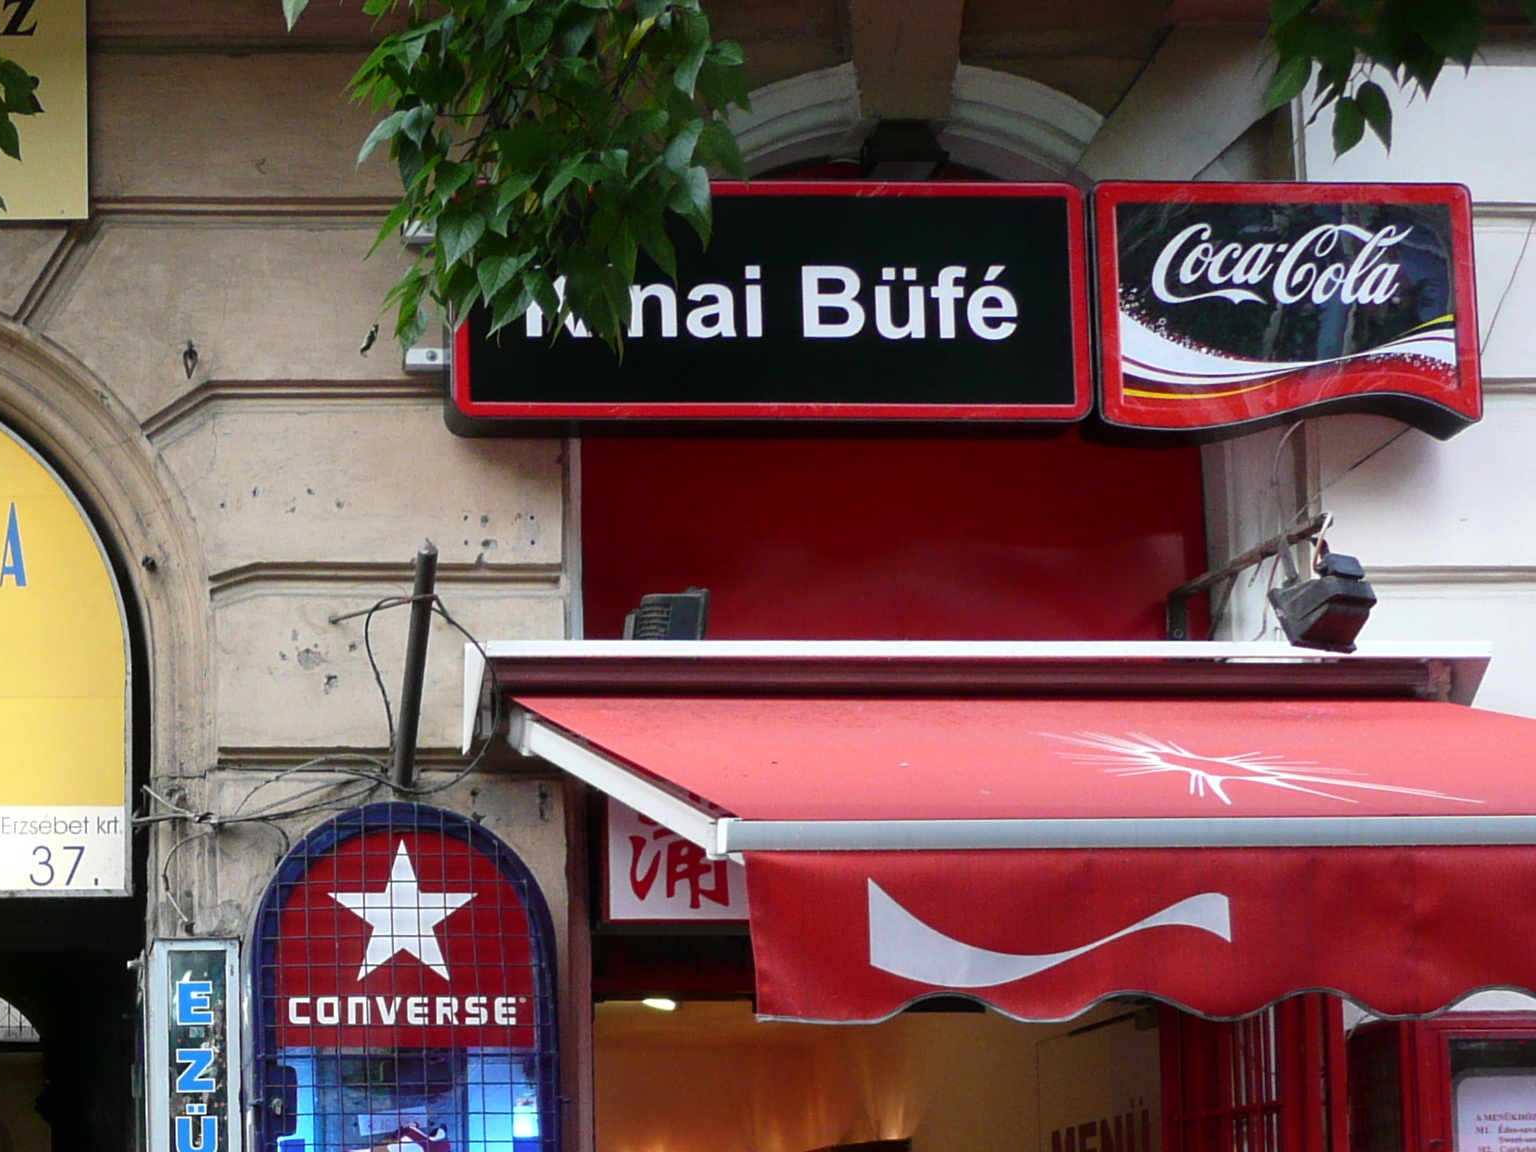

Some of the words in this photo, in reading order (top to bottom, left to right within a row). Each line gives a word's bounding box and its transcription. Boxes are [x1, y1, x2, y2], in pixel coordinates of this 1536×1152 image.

[1151, 222, 1411, 306] Coca-Cola
[526, 264, 764, 339] Knai
[800, 264, 1020, 341] Büfé
[1, 815, 92, 837] Erzsébet
[95, 815, 124, 837] krt.
[29, 845, 100, 888] 37.
[288, 997, 517, 1026] CONVERSE
